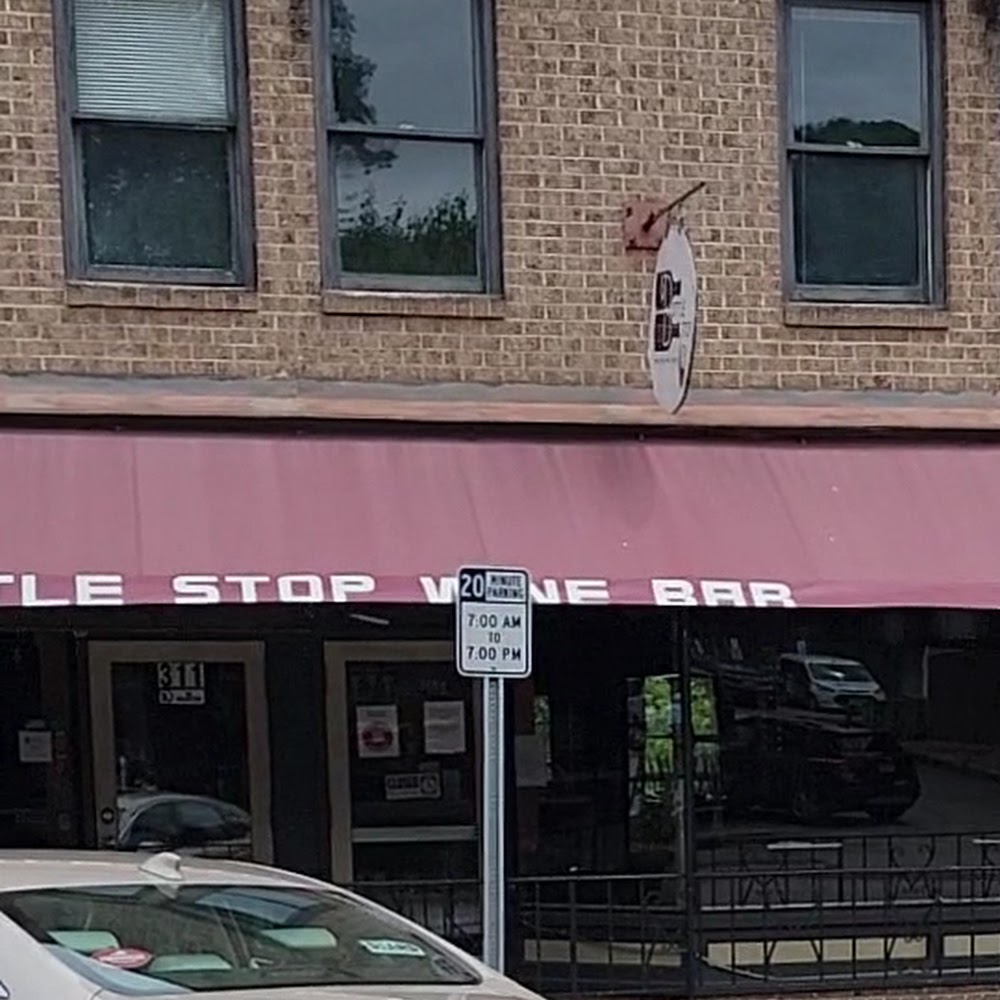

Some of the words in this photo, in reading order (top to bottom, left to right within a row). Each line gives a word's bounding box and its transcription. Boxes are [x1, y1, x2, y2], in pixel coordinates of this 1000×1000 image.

[461, 574, 485, 598] 20
[490, 575, 522, 587] MINUTE
[172, 575, 375, 604] STOP
[420, 577, 610, 605] WNE
[651, 579, 798, 607] BAR
[487, 586, 524, 599] PARKING
[467, 613, 498, 628] 7:00
[502, 615, 521, 628] AM
[489, 632, 501, 643] TO
[502, 647, 521, 660] PM
[160, 662, 201, 688] 311
